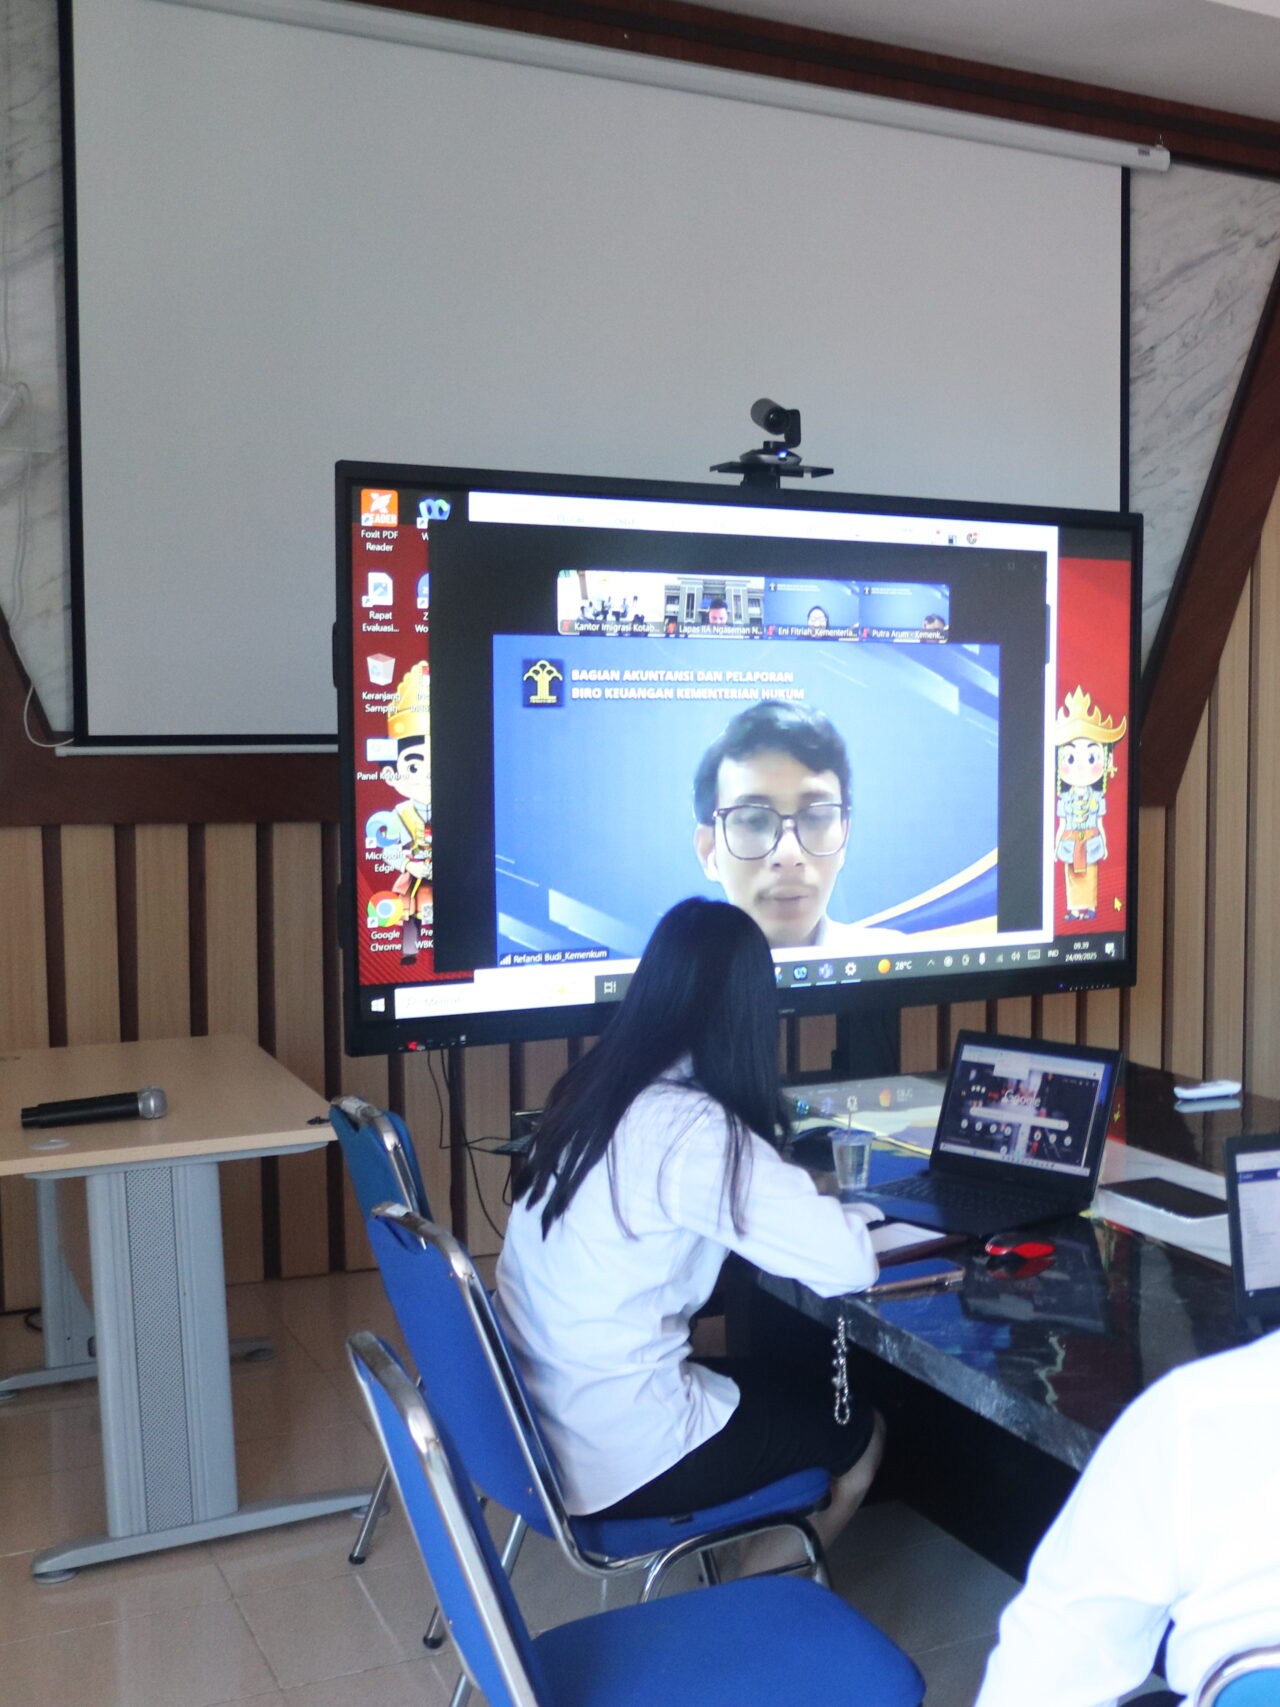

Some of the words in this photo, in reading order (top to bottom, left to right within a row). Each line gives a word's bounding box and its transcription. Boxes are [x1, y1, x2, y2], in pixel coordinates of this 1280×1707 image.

[361, 529, 380, 539] Foxit
[382, 530, 399, 540] PDF
[366, 542, 393, 552] Reader
[369, 610, 393, 621] Rapat
[574, 622, 600, 632] Kantor
[602, 622, 632, 634] Imigrasi
[778, 626, 789, 636] Eni
[872, 628, 890, 638] Putra
[891, 630, 909, 639] Arum
[571, 669, 620, 681] BAGIAN
[623, 670, 694, 682] AKUNTANSI
[697, 671, 723, 682] DAN
[726, 671, 794, 683] PELAPORAN
[362, 691, 401, 702] Keranjang
[571, 687, 602, 699] BIRO
[604, 688, 674, 700] KEUANGAN
[676, 688, 759, 700] KEMENTERIAN
[761, 689, 805, 700] HUKUM
[357, 772, 378, 781] Panel
[374, 864, 395, 873] Edge
[371, 930, 400, 941] Google
[370, 942, 402, 952] Chrome
[1047, 949, 1059, 958] IND
